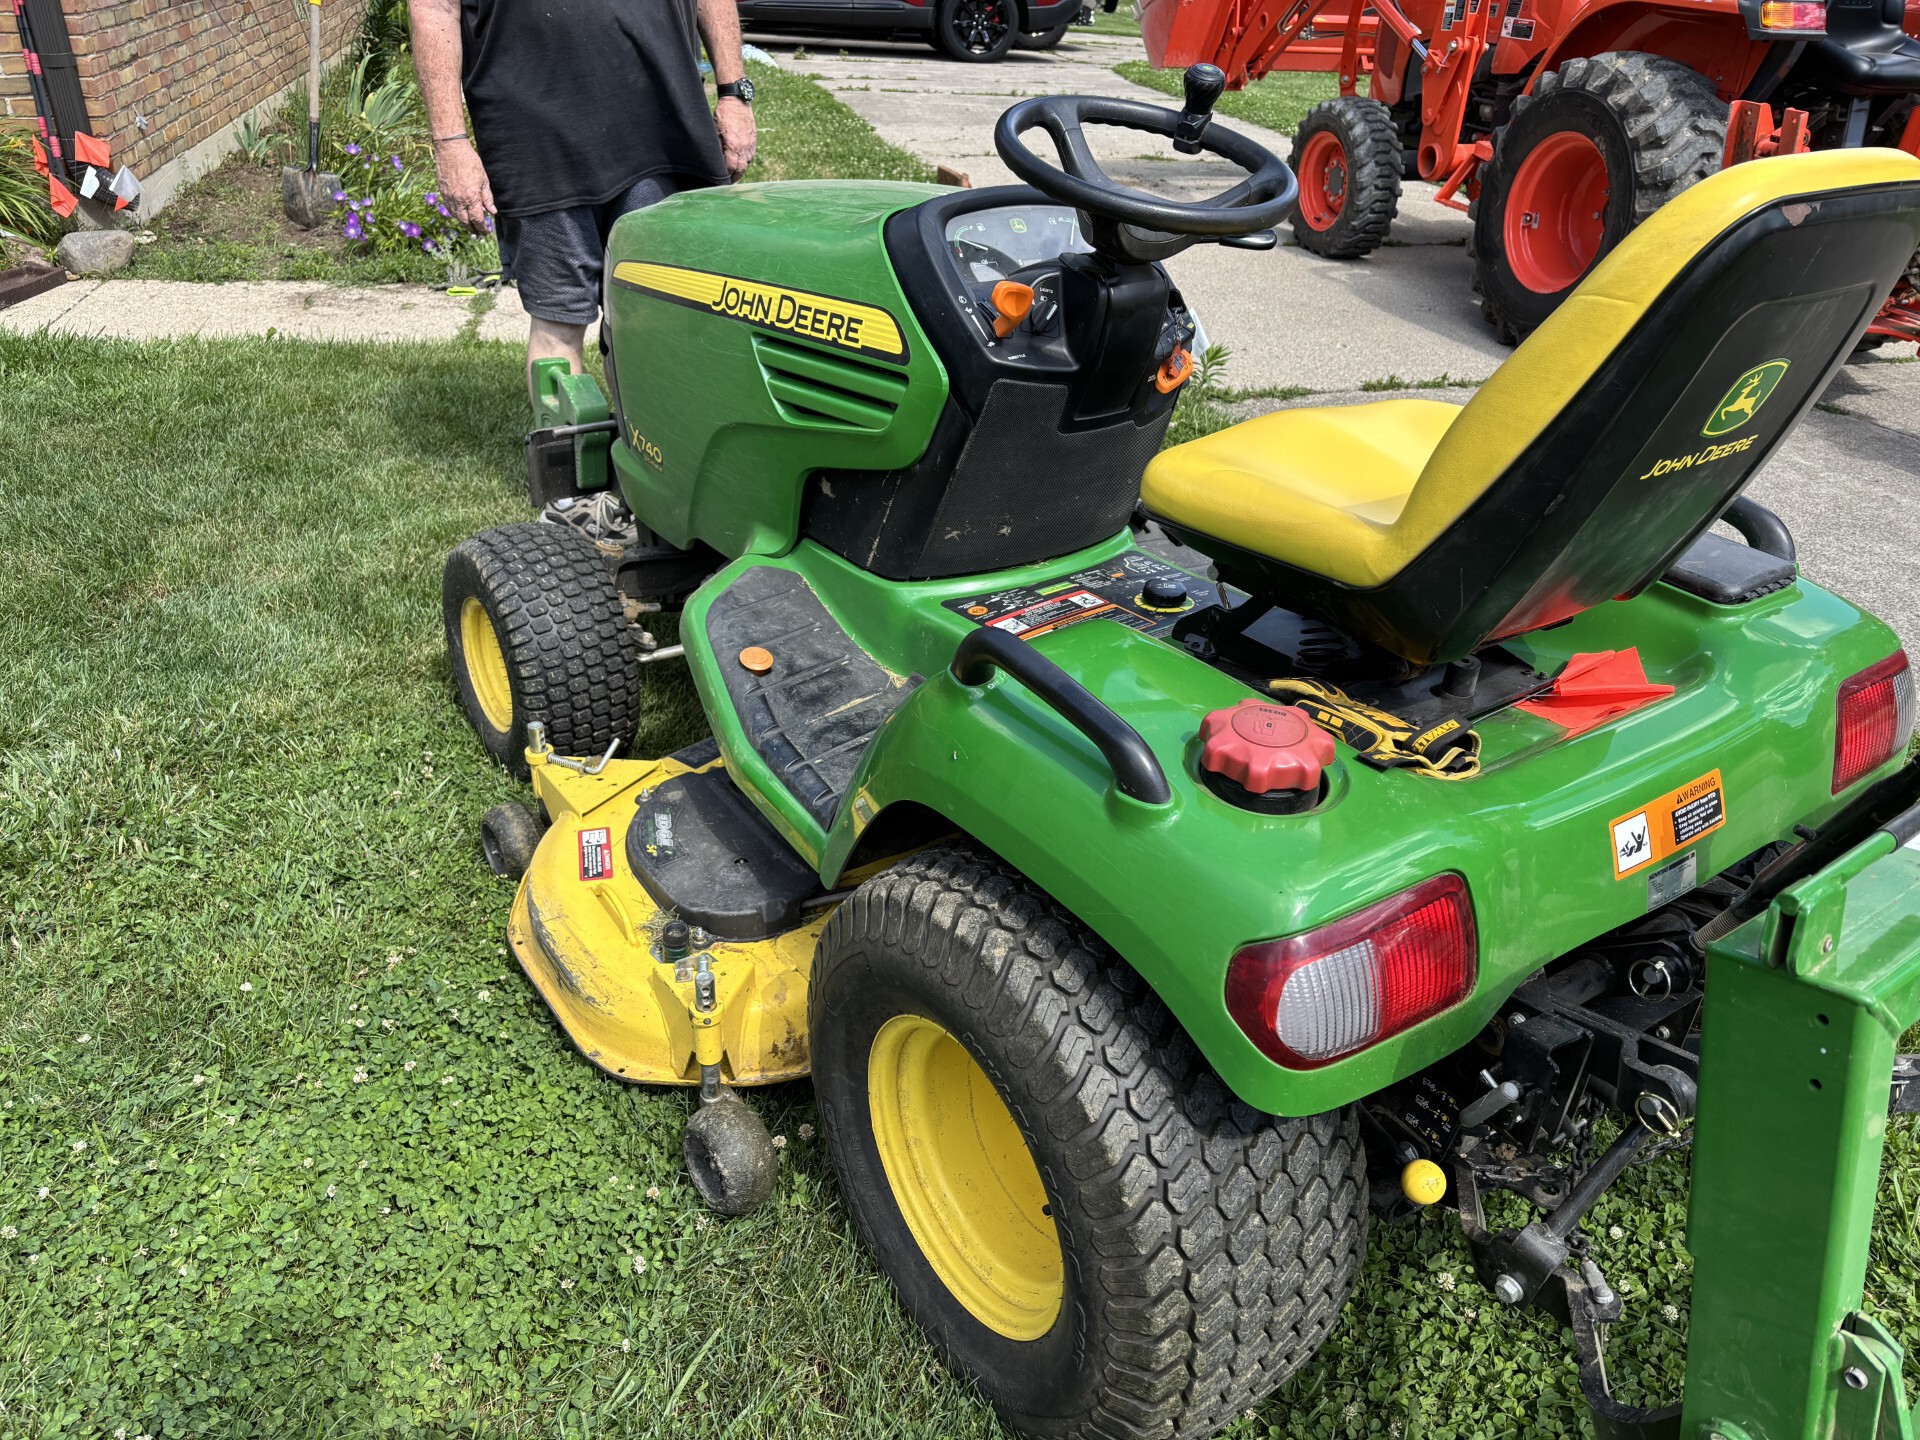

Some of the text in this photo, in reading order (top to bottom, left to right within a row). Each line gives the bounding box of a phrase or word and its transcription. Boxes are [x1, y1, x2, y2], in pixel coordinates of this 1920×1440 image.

[711, 280, 864, 344] JOHN DEERE
[630, 424, 663, 464] X740
[1640, 434, 1759, 480] JOHN DEERE
[1259, 707, 1287, 716] DIESEL
[1682, 777, 1716, 801] WARNING
[655, 812, 673, 846] EDGE
